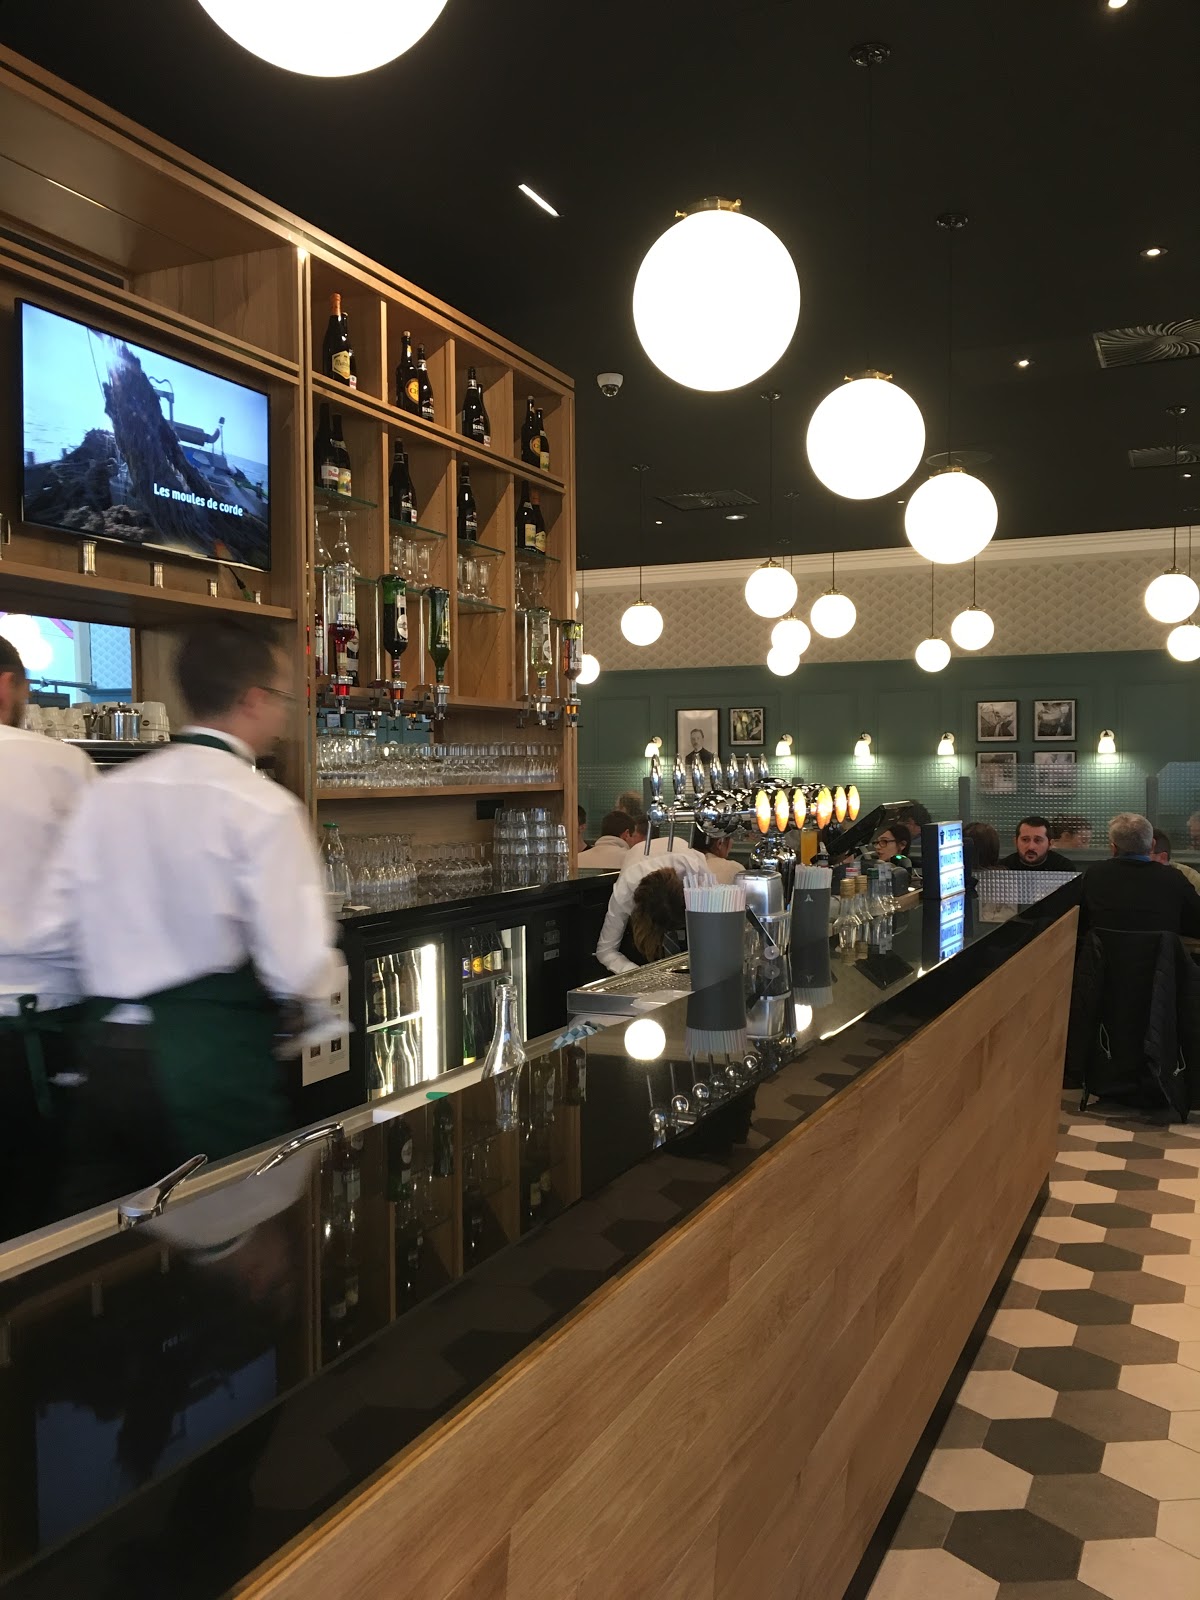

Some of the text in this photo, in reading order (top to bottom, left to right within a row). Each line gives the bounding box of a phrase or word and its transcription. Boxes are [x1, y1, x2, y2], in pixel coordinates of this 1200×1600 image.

[153, 482, 244, 517] Les moules de corde
